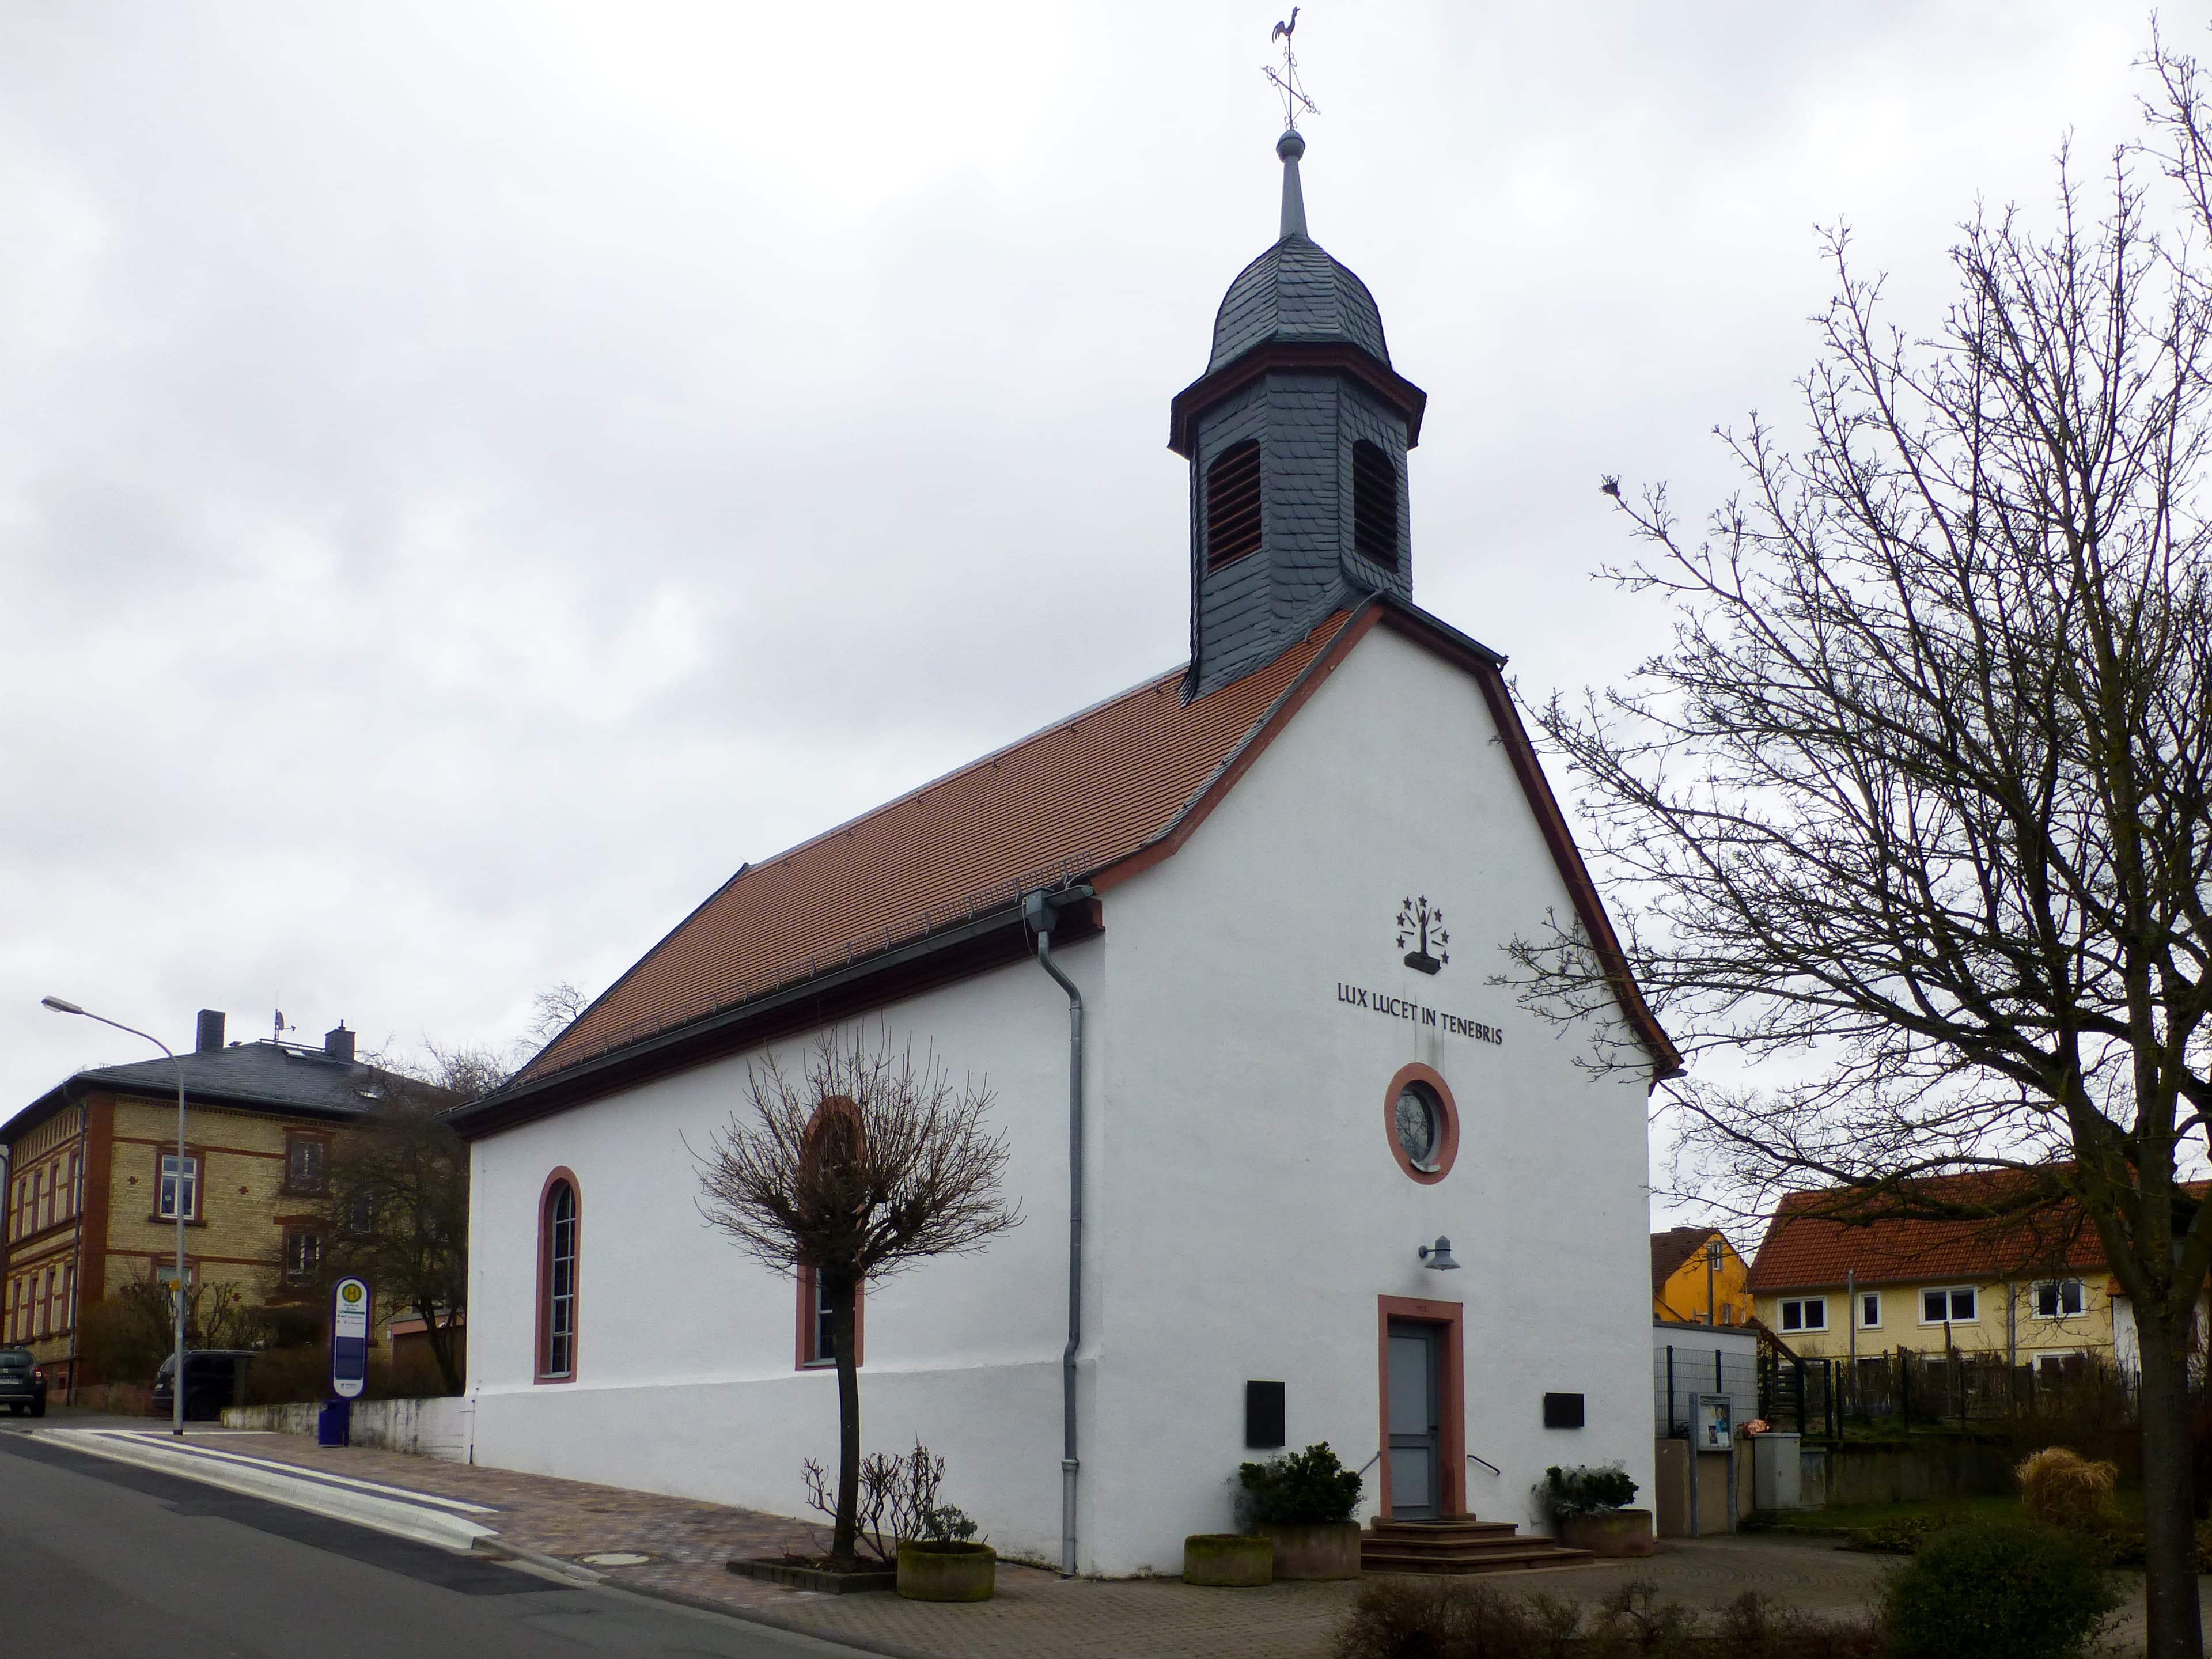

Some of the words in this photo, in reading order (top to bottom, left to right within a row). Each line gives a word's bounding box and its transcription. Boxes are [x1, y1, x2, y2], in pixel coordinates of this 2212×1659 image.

[1338, 983, 1368, 1007] LUX
[1373, 993, 1418, 1021] LUCET
[1422, 1007, 1436, 1027] IN
[1441, 1013, 1503, 1045] TENEBRIS
[347, 1288, 356, 1299] H
